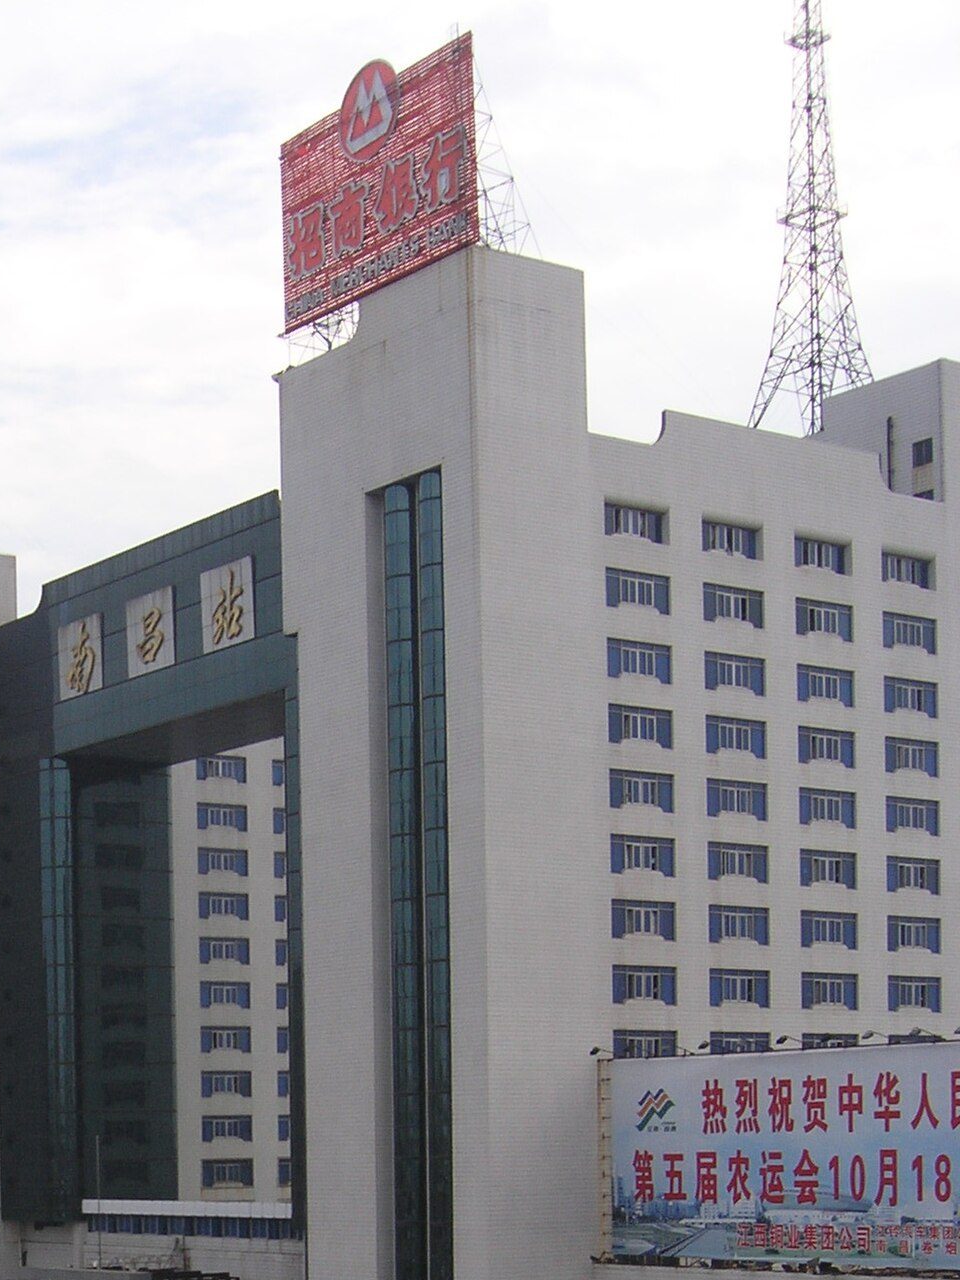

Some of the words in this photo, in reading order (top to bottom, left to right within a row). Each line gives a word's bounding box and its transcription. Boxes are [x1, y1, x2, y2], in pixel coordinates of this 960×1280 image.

[286, 124, 469, 281] 招商银行
[736, 1223, 871, 1255] 江西铜业集团公司
